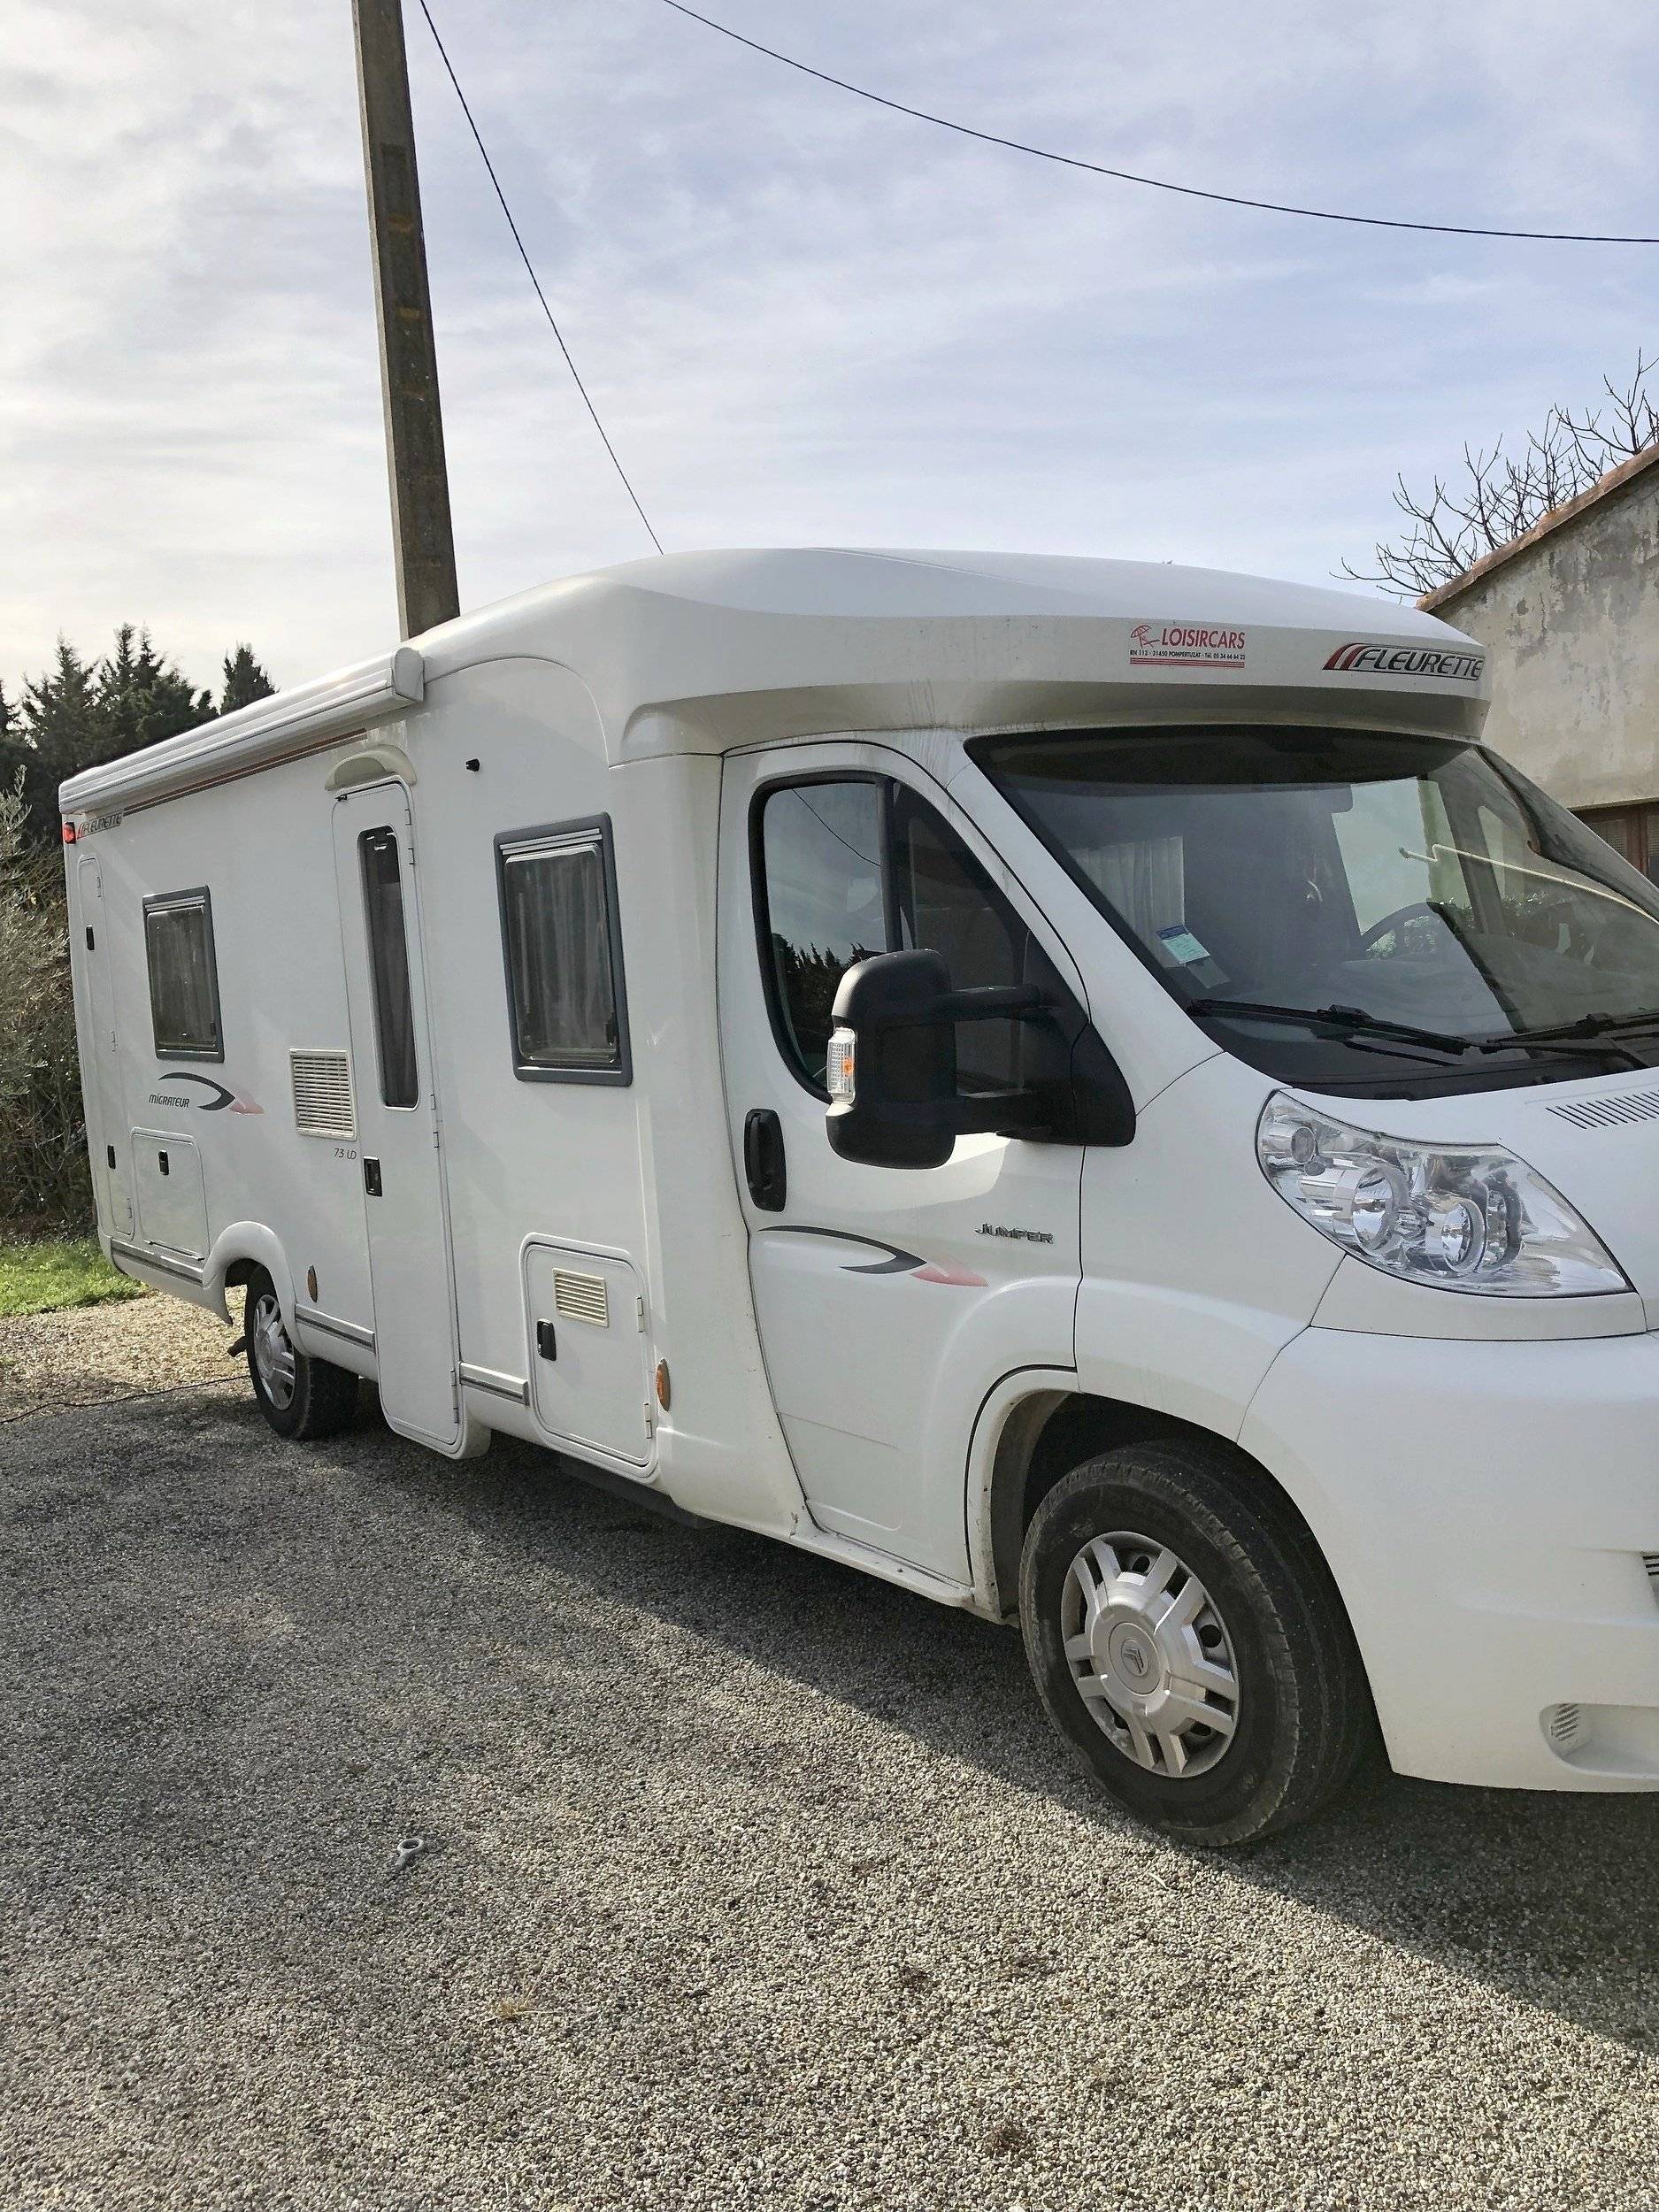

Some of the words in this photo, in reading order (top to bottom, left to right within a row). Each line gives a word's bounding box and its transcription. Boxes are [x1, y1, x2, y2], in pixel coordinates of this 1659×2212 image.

[1162, 628, 1245, 649] LOISIRCARS
[1353, 649, 1483, 678] FLEURETTE
[334, 1148, 344, 1158] 73
[974, 1223, 1054, 1245] JUMPER
